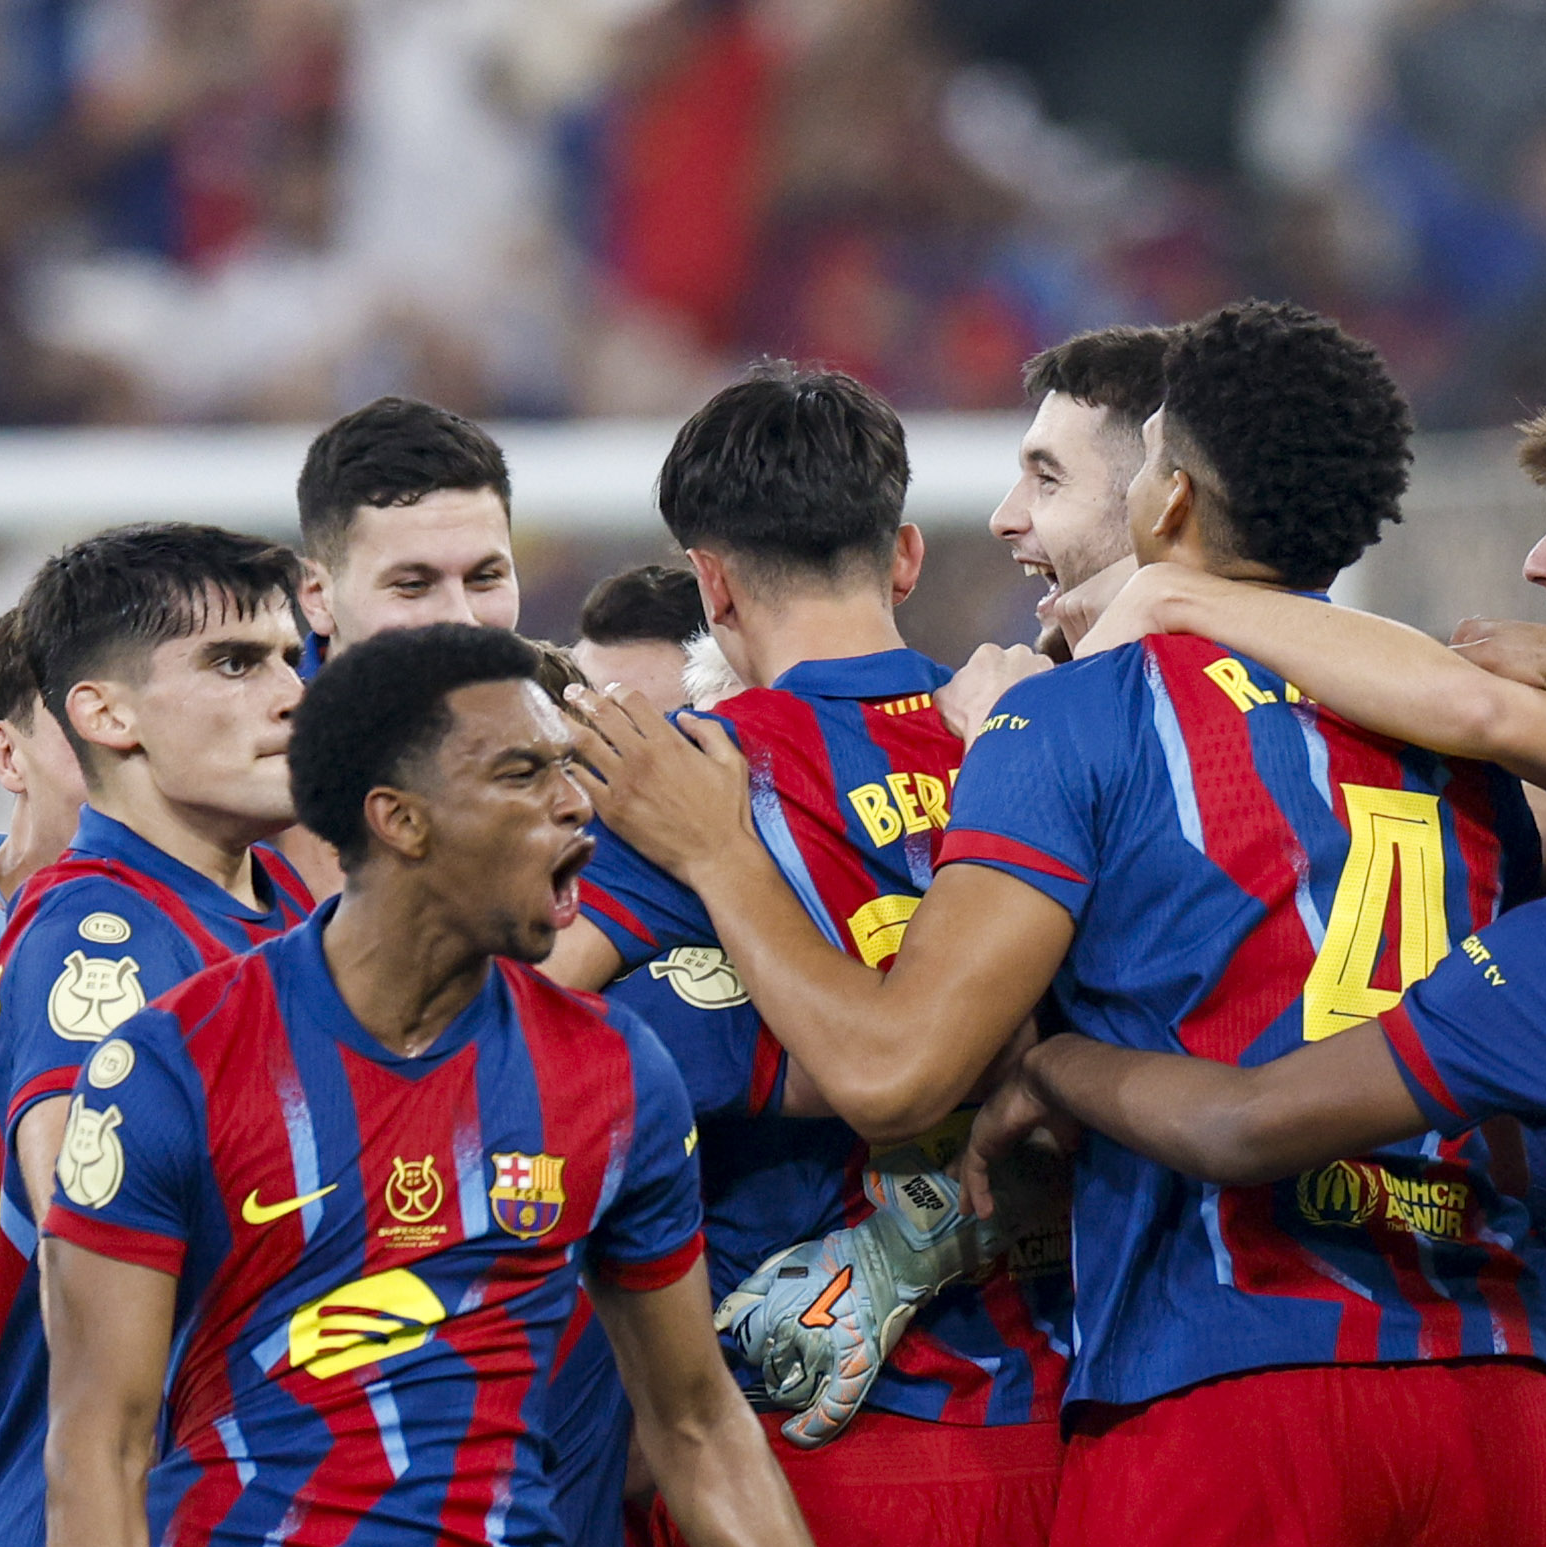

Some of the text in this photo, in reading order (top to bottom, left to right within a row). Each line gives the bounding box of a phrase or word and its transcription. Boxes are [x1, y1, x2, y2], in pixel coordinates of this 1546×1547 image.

[93, 922, 117, 934] 15
[1303, 783, 1449, 1042] 4
[901, 1183, 930, 1210] JOAN
[1379, 1168, 1470, 1209] UNHCR
[1385, 1195, 1464, 1239] ACNUR
